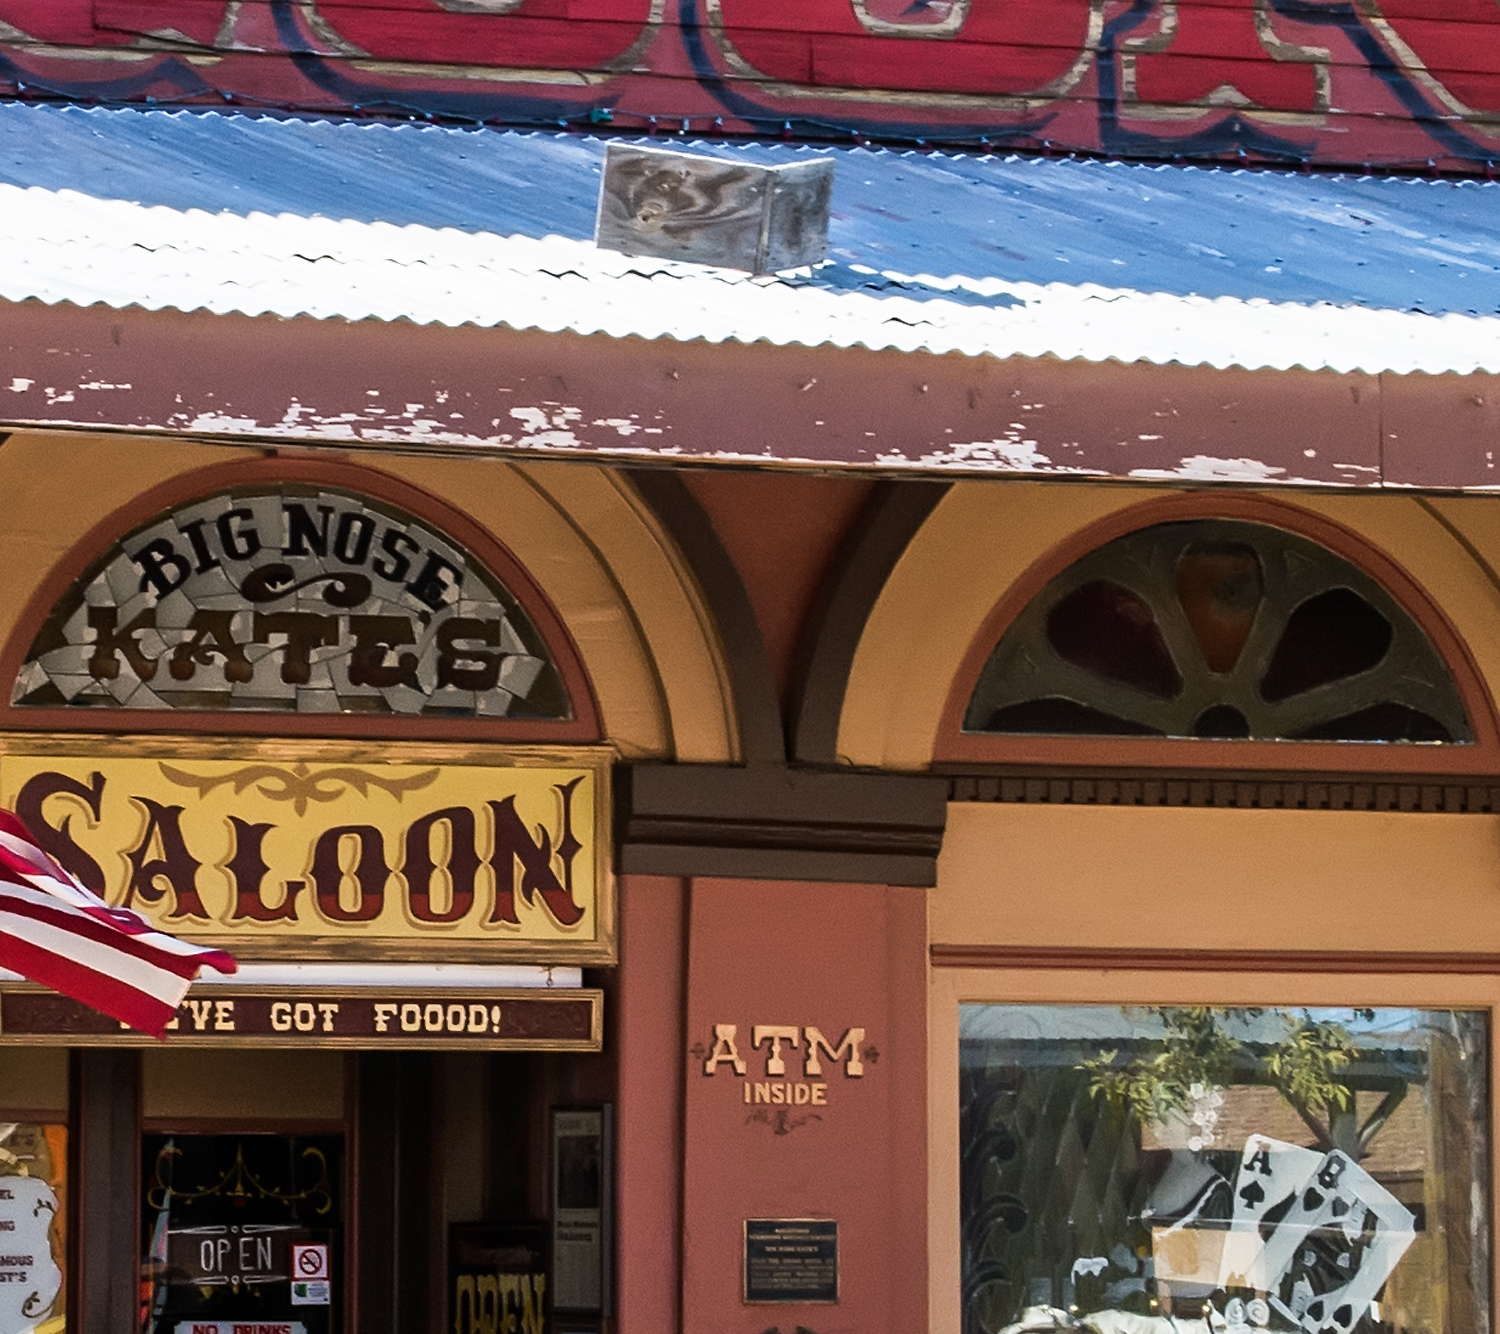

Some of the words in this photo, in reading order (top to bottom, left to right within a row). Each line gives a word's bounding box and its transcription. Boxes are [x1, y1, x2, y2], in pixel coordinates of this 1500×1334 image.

[132, 506, 260, 601] BIG
[281, 504, 465, 612] NOSE
[86, 605, 503, 691] KATE'S
[16, 771, 588, 931] SALOON
[270, 1003, 339, 1032] GOT
[374, 1003, 502, 1034] FOOOD!
[704, 1023, 866, 1078] ATM
[743, 1082, 829, 1106] INSIDE
[200, 1236, 273, 1272] OPEN
